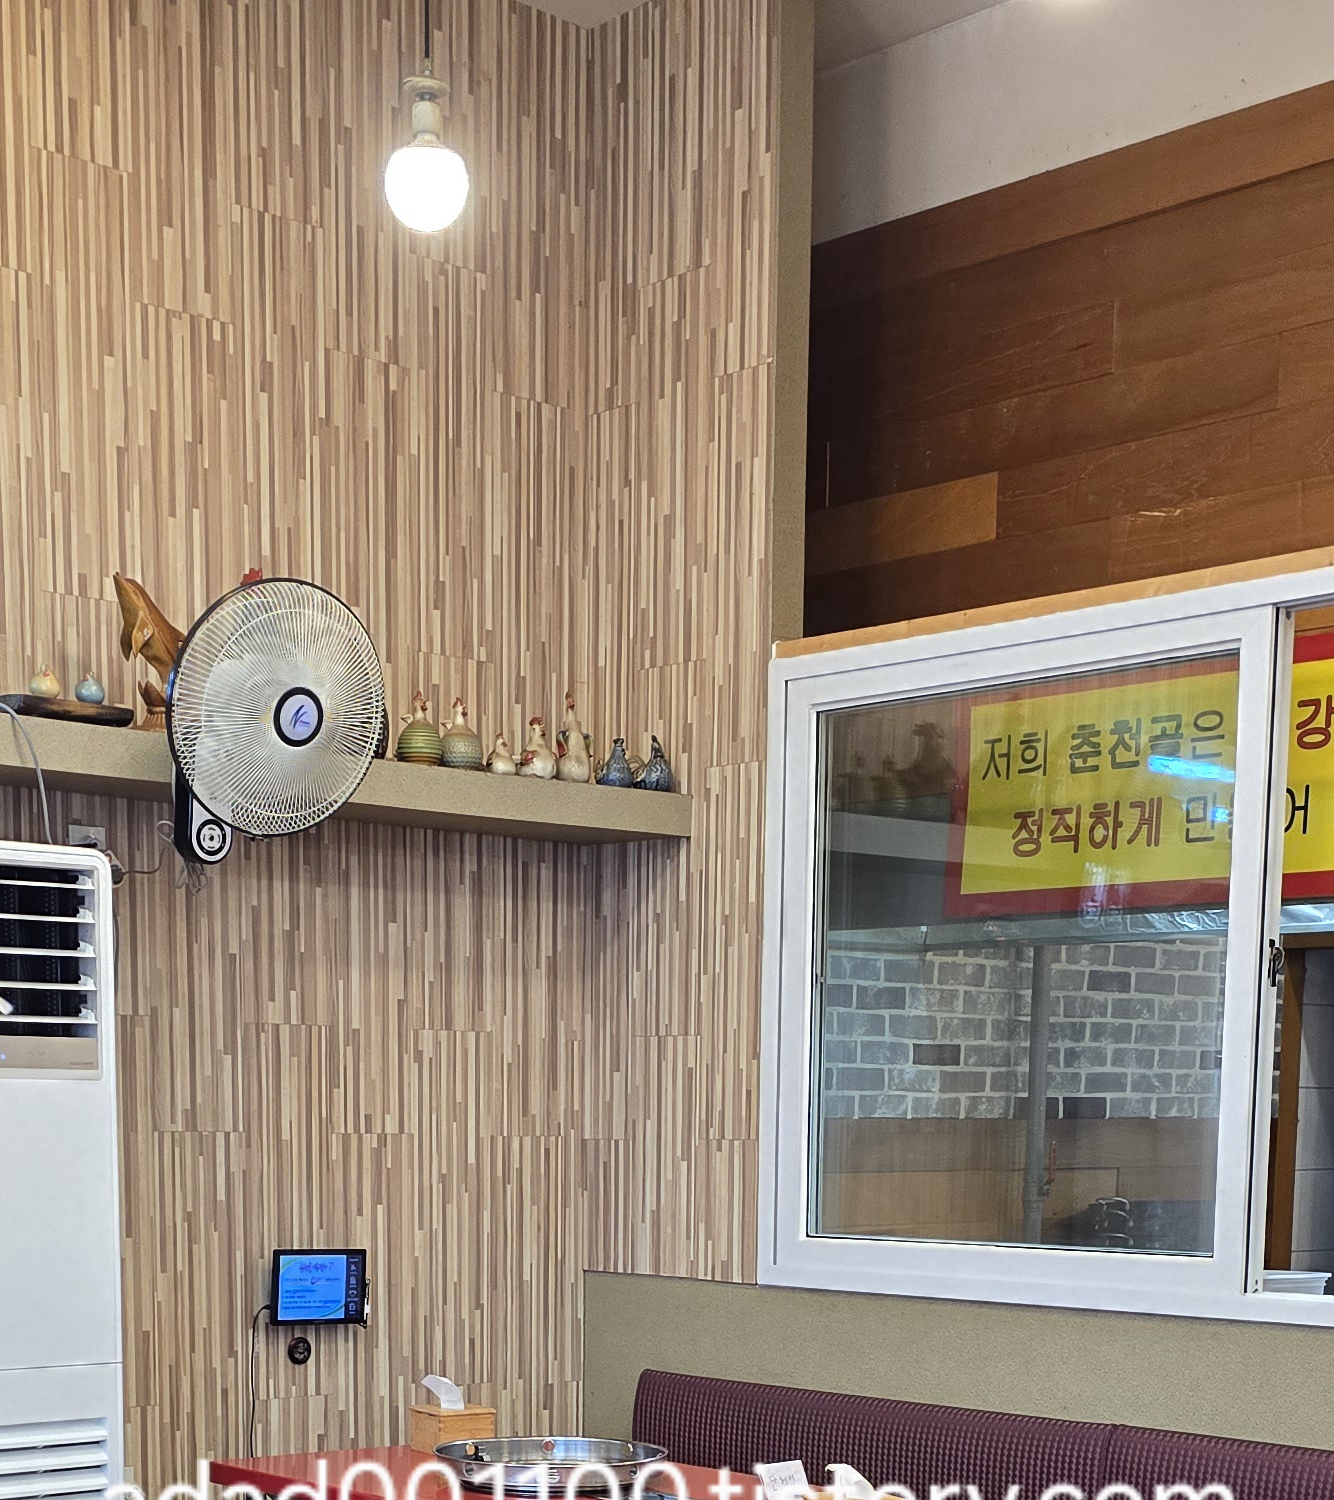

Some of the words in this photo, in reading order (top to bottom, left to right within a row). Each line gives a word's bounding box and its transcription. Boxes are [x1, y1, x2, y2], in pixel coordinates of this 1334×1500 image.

[982, 732, 1048, 781] 저희
[1068, 709, 1226, 775] 춘천골은
[1011, 801, 1162, 858] 정직하게
